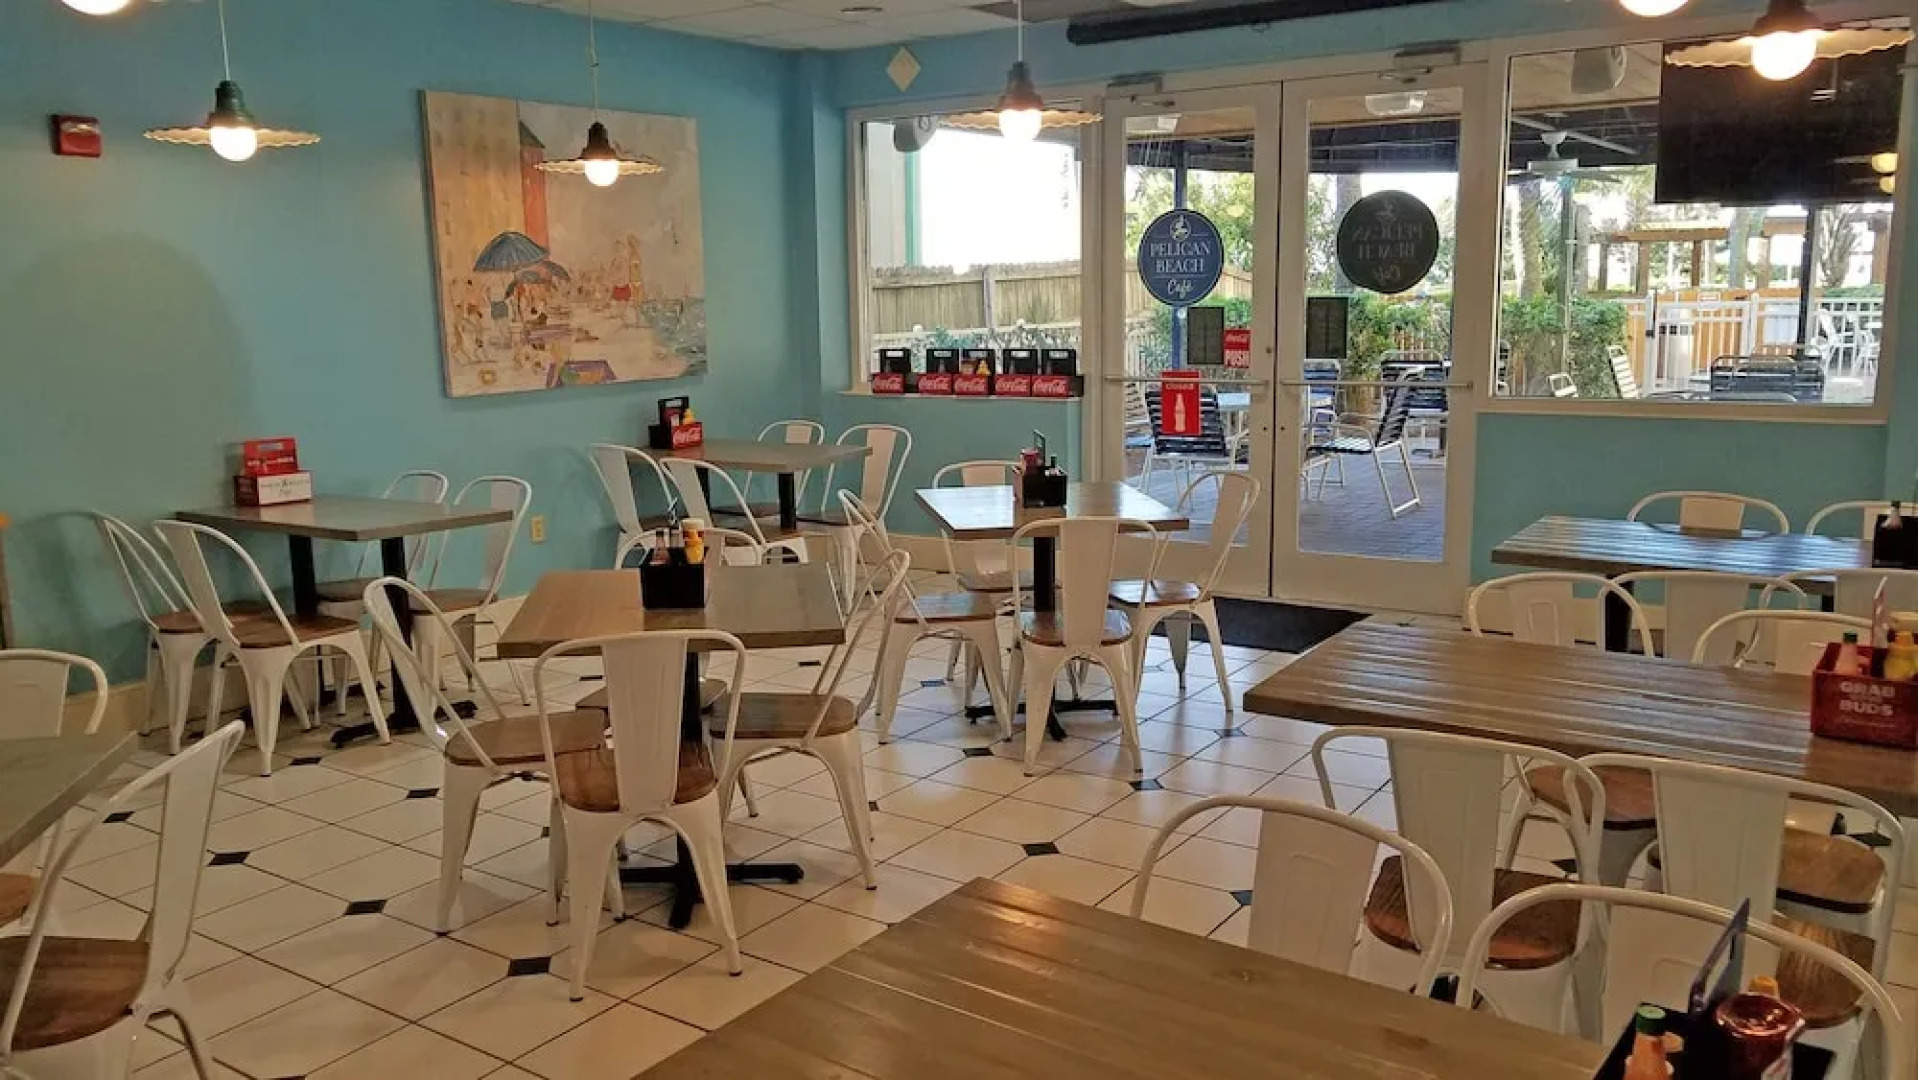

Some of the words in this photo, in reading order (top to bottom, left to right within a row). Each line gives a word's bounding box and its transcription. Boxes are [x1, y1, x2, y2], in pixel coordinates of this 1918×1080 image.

[1150, 241, 1211, 257] PELICAN
[1155, 258, 1204, 273] BEACH
[1840, 681, 1895, 698] GRAB
[1839, 700, 1893, 717] BUDS
